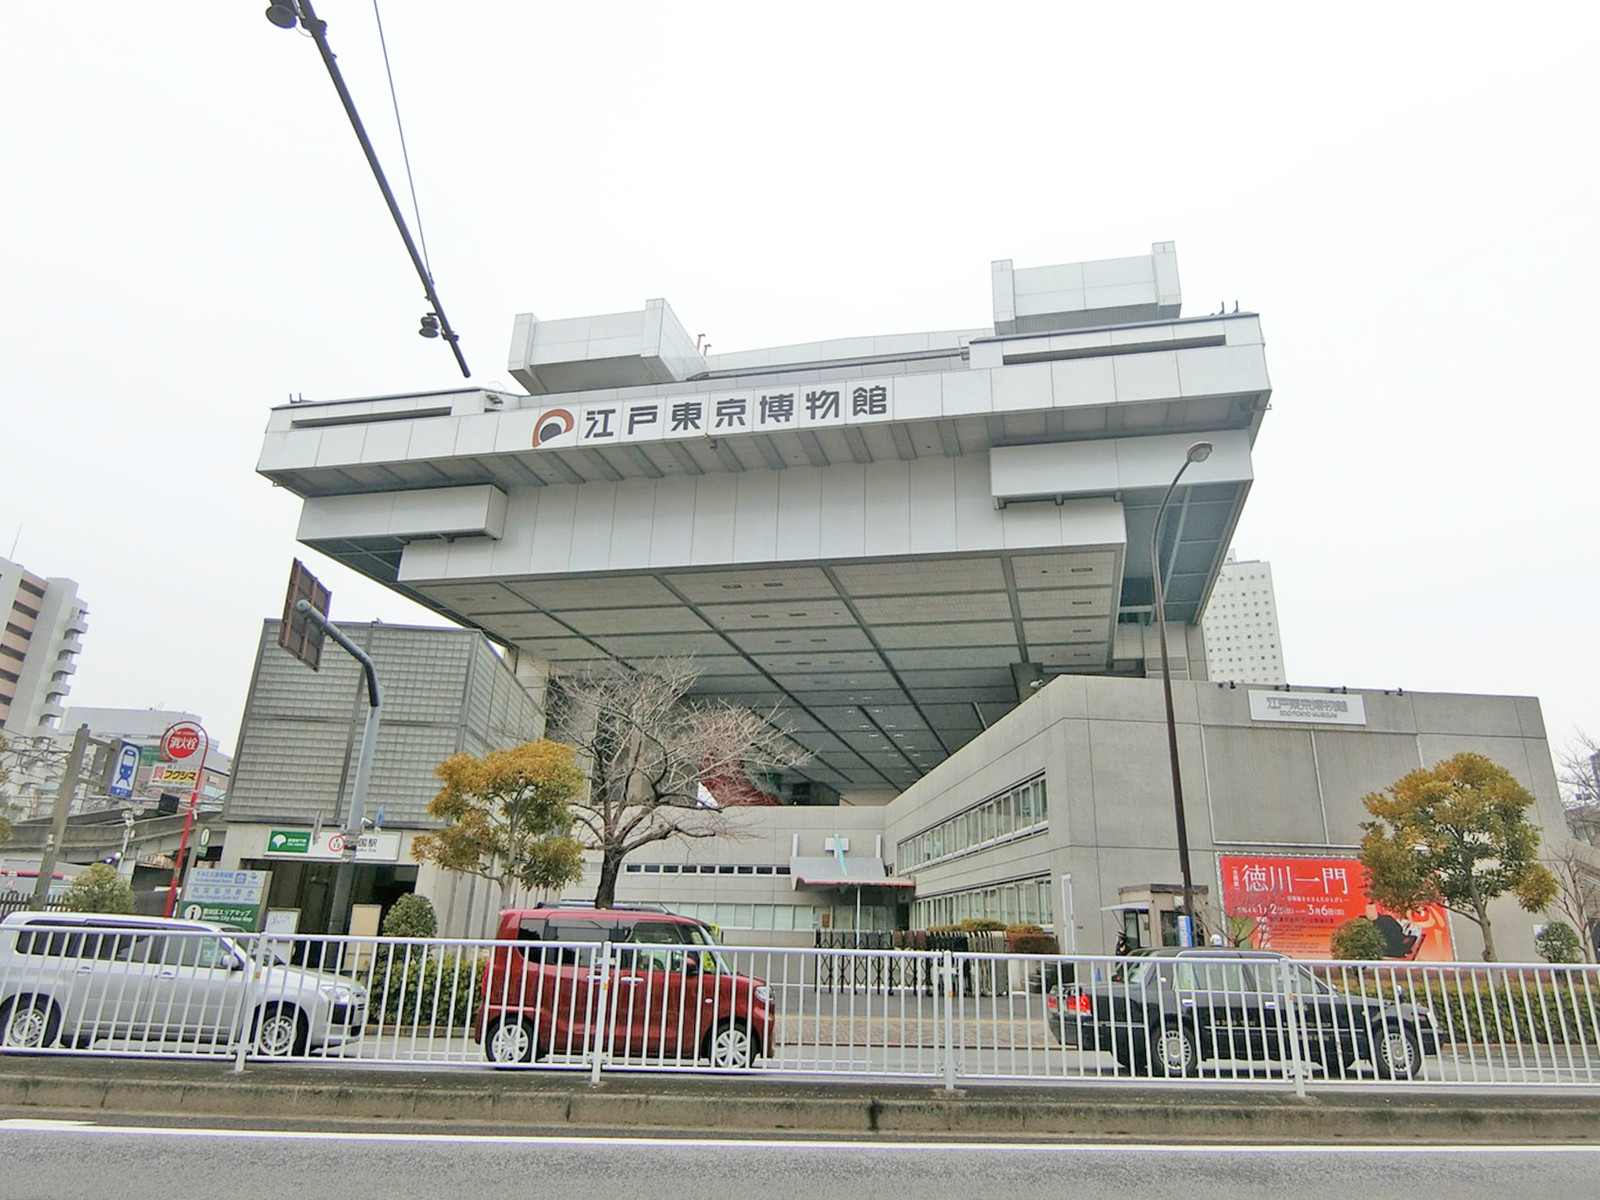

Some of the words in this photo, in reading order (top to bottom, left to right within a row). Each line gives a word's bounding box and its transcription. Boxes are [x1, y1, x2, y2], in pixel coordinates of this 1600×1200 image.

[584, 385, 888, 439] 江戸東京博物館
[169, 736, 198, 750] 消火栓
[164, 769, 197, 781] フクシマ
[1241, 864, 1349, 895] 徳川一門
